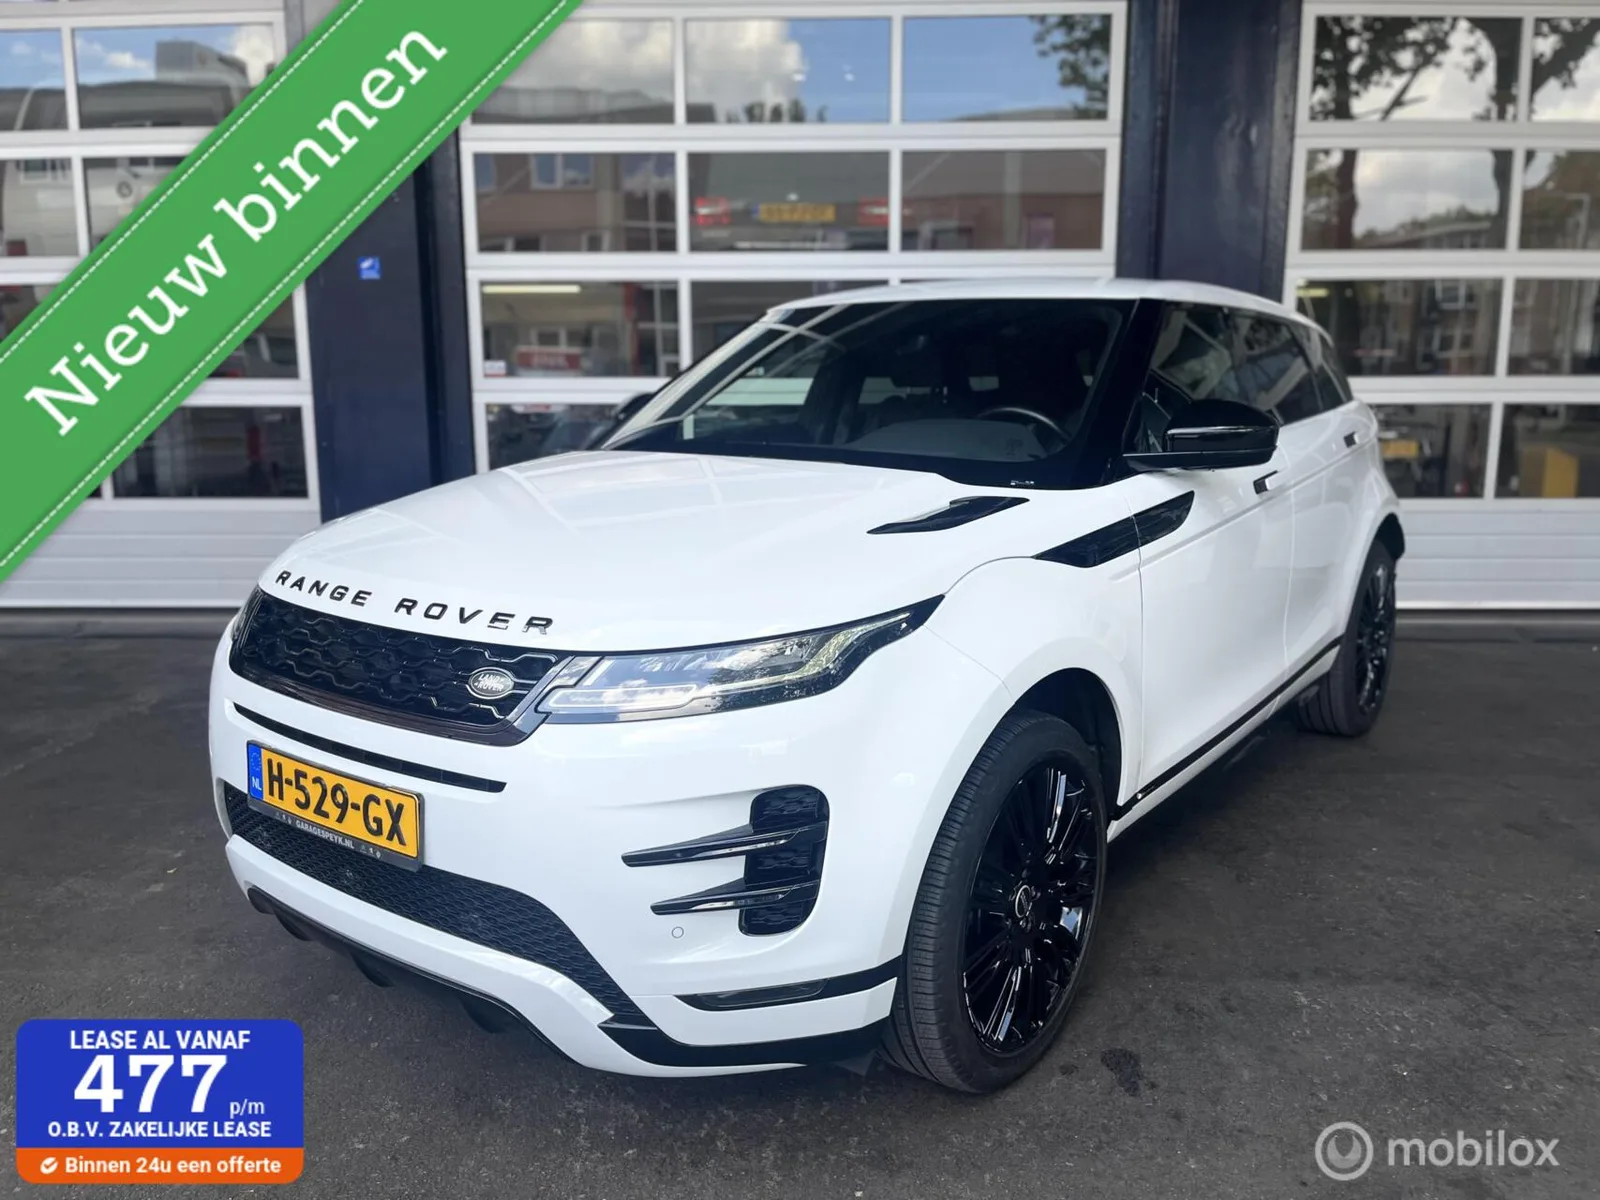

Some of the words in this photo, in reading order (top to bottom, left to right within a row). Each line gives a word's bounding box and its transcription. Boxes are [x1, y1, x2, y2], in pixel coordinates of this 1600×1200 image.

[275, 570, 373, 607] RANGE
[394, 598, 554, 635] ROVER
[252, 776, 262, 791] NL
[267, 758, 407, 847] H-529-GX
[295, 820, 355, 850] GARAGESPEYK.NL
